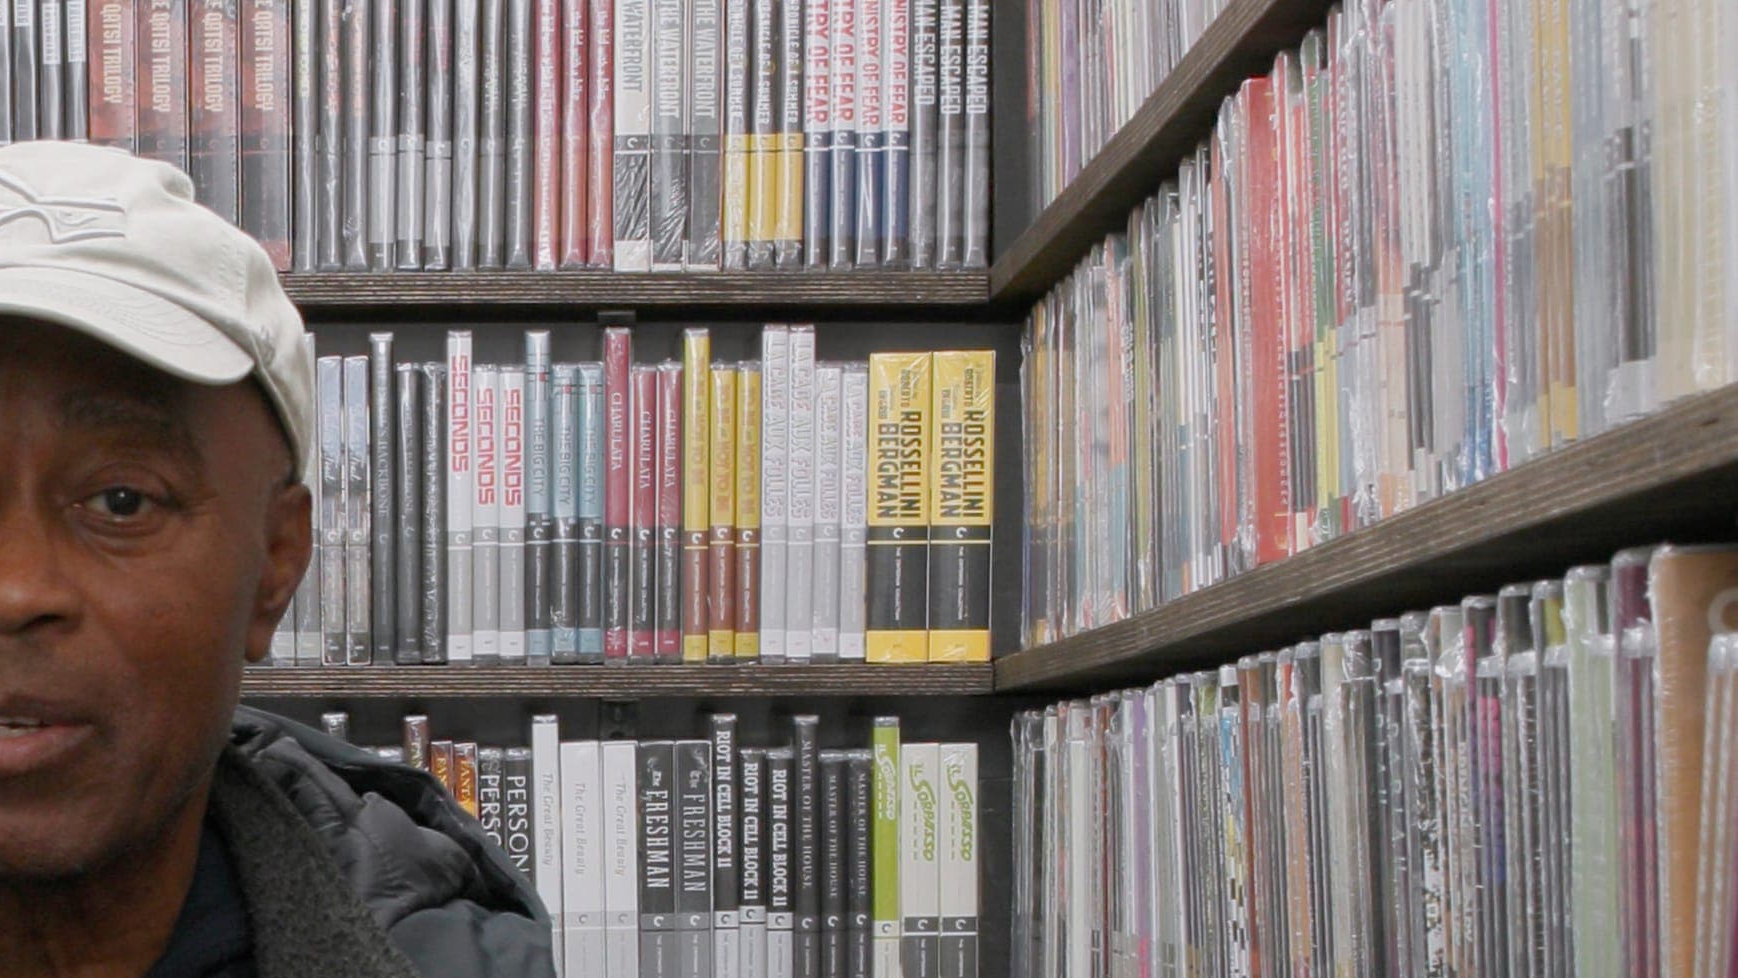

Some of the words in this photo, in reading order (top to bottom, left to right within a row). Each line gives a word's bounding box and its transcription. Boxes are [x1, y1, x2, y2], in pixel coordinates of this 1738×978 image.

[102, 4, 122, 45] QATSI
[151, 12, 170, 53] QATSI
[203, 12, 223, 53] QATSI
[252, 11, 272, 51] QATSI
[939, 5, 961, 40] MAN
[966, 5, 987, 40] MAN
[622, 2, 643, 93] WATERFRONT
[103, 47, 122, 104] TRILOGY
[152, 58, 171, 112] TRILOGY
[204, 58, 224, 112] TRILOGY
[254, 56, 273, 111] TRILOGY
[659, 28, 679, 119] WATERFRONT
[694, 28, 715, 119] WATERFRONT
[862, 62, 879, 81] OF
[914, 33, 935, 105] ESCAPED
[940, 45, 961, 114] ESCAPED
[965, 45, 988, 114] ESCAPED
[757, 81, 770, 124] SUMMER
[786, 79, 798, 123] SUMMER
[862, 86, 879, 126] FEAR
[451, 355, 468, 472] SECONDS
[532, 417, 546, 444] THE
[610, 392, 622, 471] CHARULATA
[503, 388, 521, 506] SECONDS
[533, 447, 546, 470] BIG
[639, 410, 651, 488] CHARULATA
[900, 411, 921, 518] ROSSELLINI
[962, 410, 984, 518] ROSSELLINI
[533, 472, 547, 496] CITY
[791, 457, 812, 519] FOLLES
[877, 424, 899, 518] BERGMAN
[940, 423, 962, 518] BERGMAN
[716, 731, 731, 762] RIOT
[801, 740, 813, 791] MASTER
[616, 783, 626, 802] The
[717, 766, 731, 781] IN
[772, 769, 786, 801] RIOT
[717, 784, 731, 813] CELL
[773, 806, 787, 820] IN
[802, 795, 812, 812] OF
[506, 776, 529, 873] PERSON
[616, 806, 626, 835] Great
[645, 790, 670, 888] FRESHMAN
[717, 815, 732, 854] BLOCK
[772, 823, 787, 852] CELL
[802, 816, 812, 842] THE
[614, 839, 626, 876] Beauty
[682, 794, 707, 892] FRESHMAN
[773, 854, 788, 893] BLOCK
[802, 847, 813, 889] HOUSE
